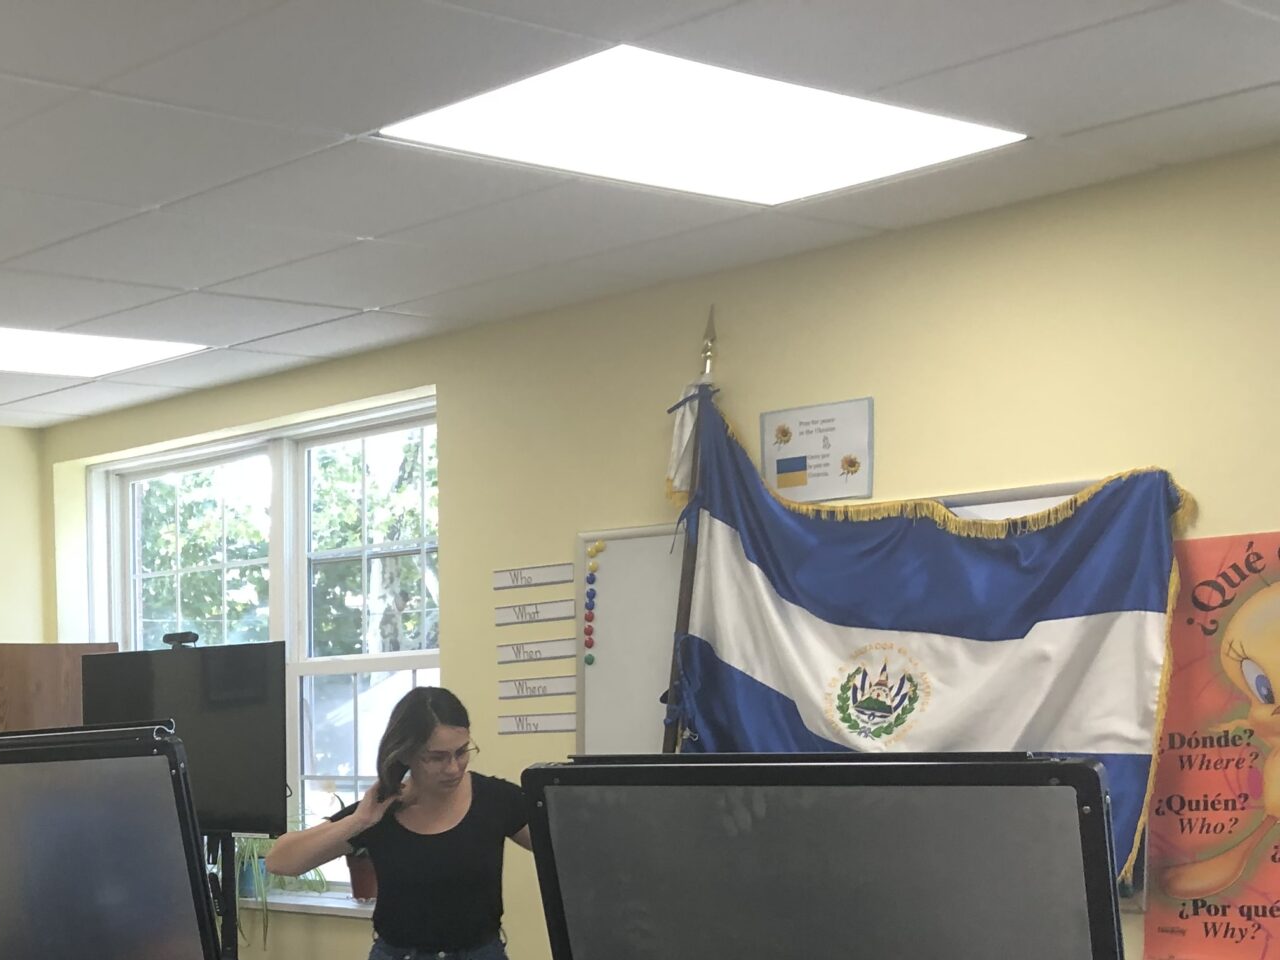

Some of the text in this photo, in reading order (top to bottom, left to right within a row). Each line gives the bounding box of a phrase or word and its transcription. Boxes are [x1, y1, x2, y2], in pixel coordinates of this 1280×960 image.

[509, 571, 532, 584] Who
[1186, 541, 1267, 636] ¿Qué
[513, 605, 541, 620] What
[512, 645, 542, 659] When
[514, 681, 548, 695] Where
[514, 717, 539, 732] Why
[1178, 752, 1259, 771] Where?
[1154, 793, 1249, 817] ¿Quién?
[1178, 817, 1239, 835] Who?
[1178, 899, 1231, 920] ¿Por
[1202, 921, 1262, 944] Why?
